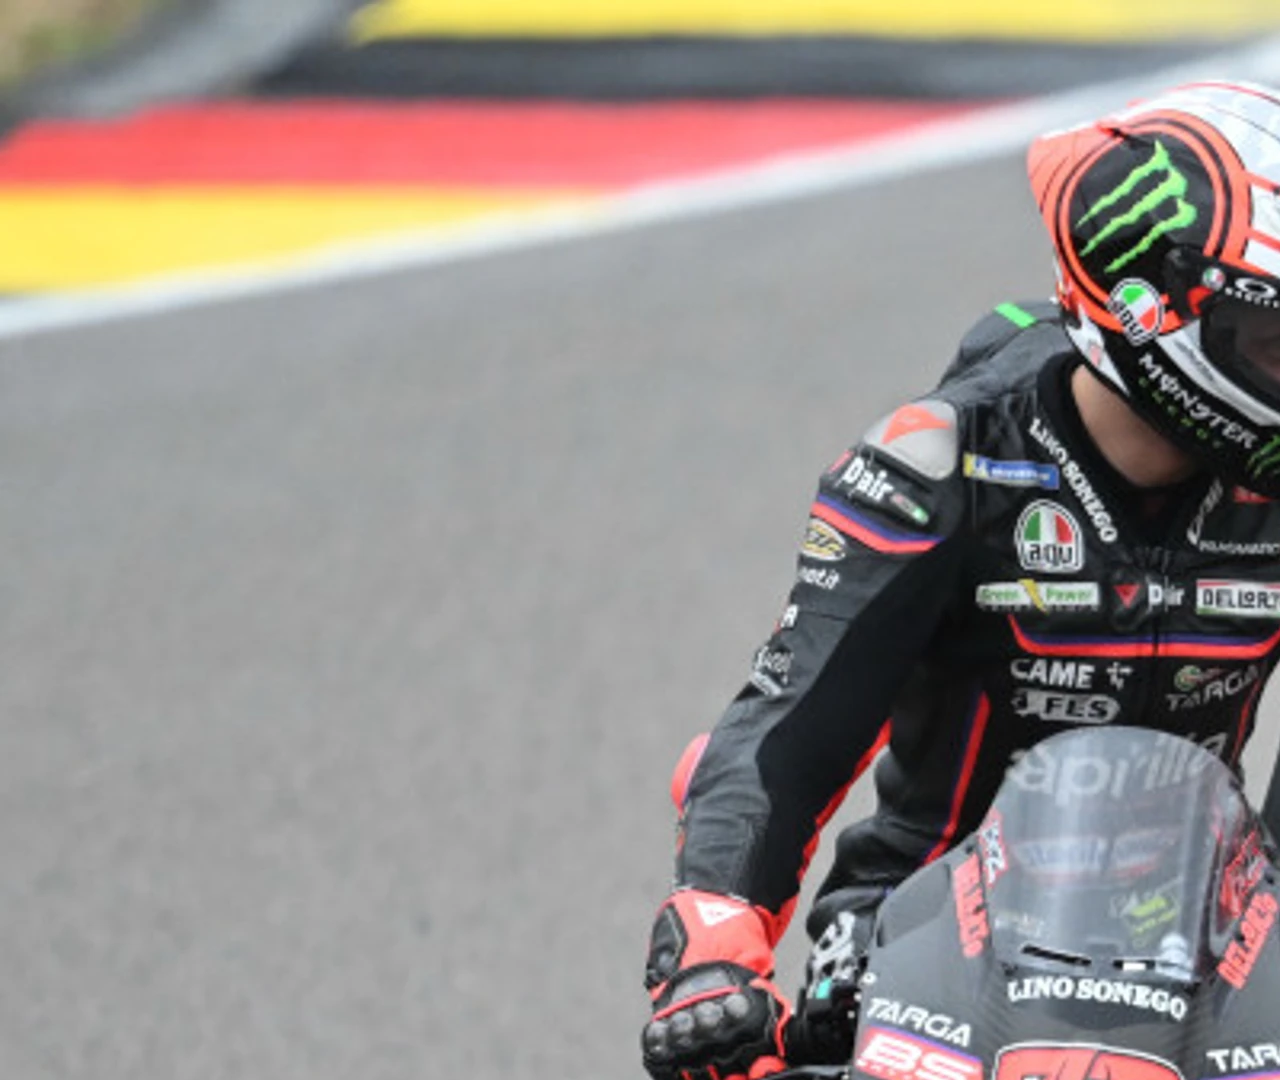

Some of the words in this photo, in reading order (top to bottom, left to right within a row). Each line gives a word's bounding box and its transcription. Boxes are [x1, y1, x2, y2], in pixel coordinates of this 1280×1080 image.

[1137, 352, 1261, 448] MONSTER
[1010, 658, 1096, 690] CAME
[1007, 976, 1074, 1002] LINO
[1075, 976, 1188, 1021] SONEGO
[865, 998, 972, 1047] TARGA
